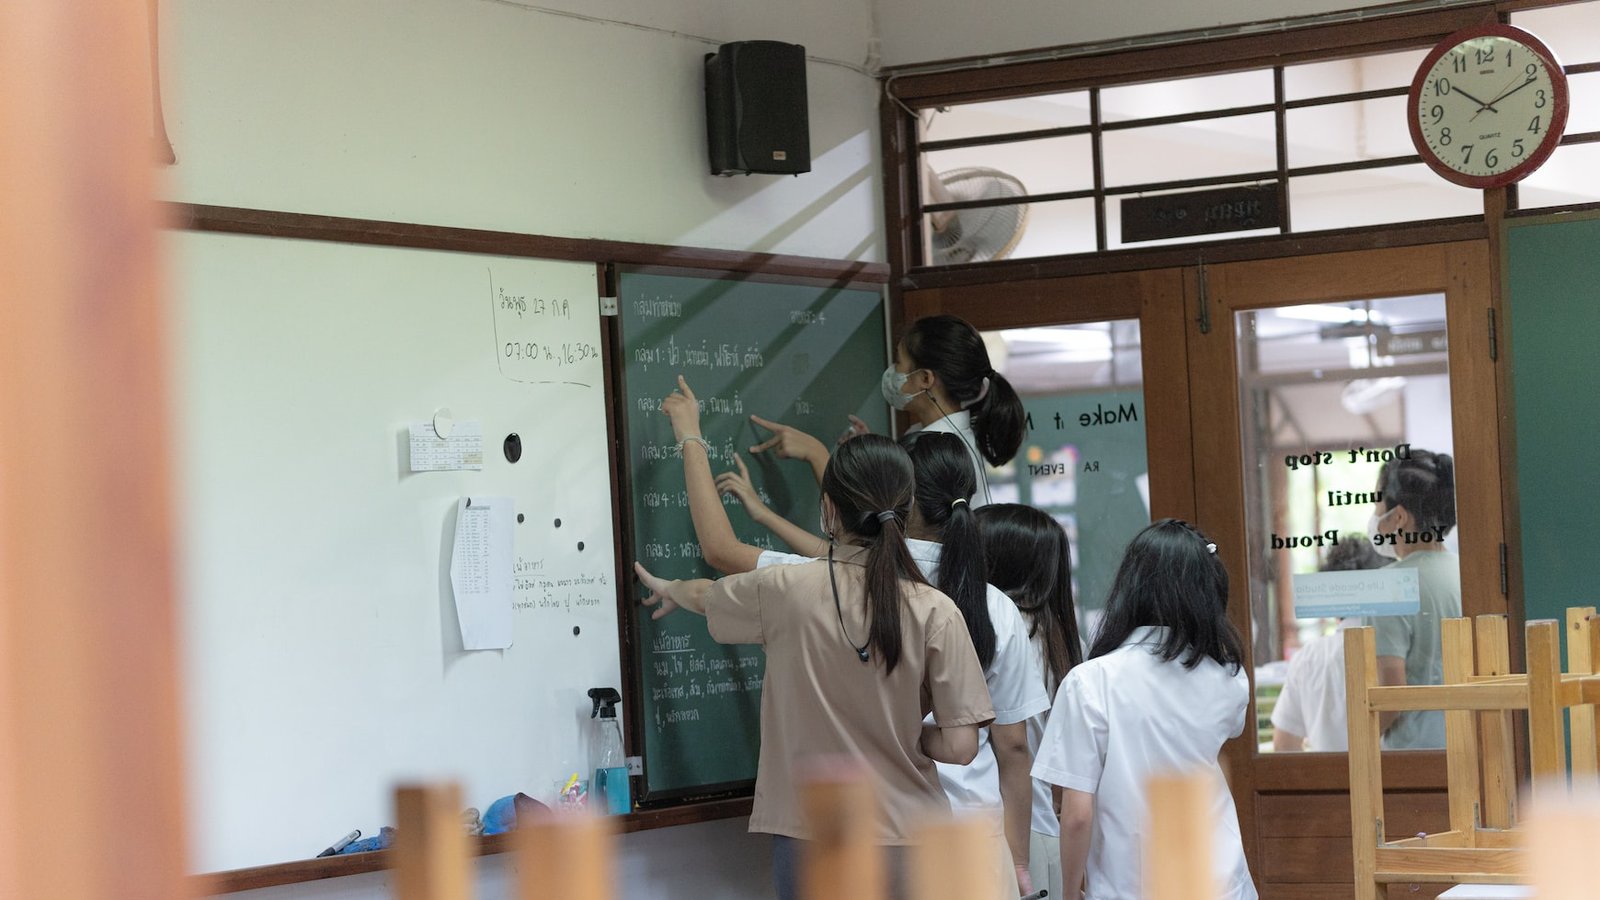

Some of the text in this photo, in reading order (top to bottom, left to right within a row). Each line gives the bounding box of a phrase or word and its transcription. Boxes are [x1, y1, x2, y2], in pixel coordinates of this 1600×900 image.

[1452, 55, 1466, 73] 11
[1475, 45, 1495, 65] 12
[1506, 48, 1513, 67] 1
[1525, 63, 1537, 82] 2
[1433, 77, 1450, 97] 10
[1534, 89, 1546, 109] 3
[1431, 104, 1444, 125] 9
[1527, 115, 1541, 135] 4
[1439, 127, 1452, 146] 8
[1479, 132, 1501, 140] QUARTZ
[1461, 144, 1474, 165] 7
[1485, 147, 1498, 169] 6
[1511, 138, 1524, 158] 5
[534, 298, 545, 315] 27
